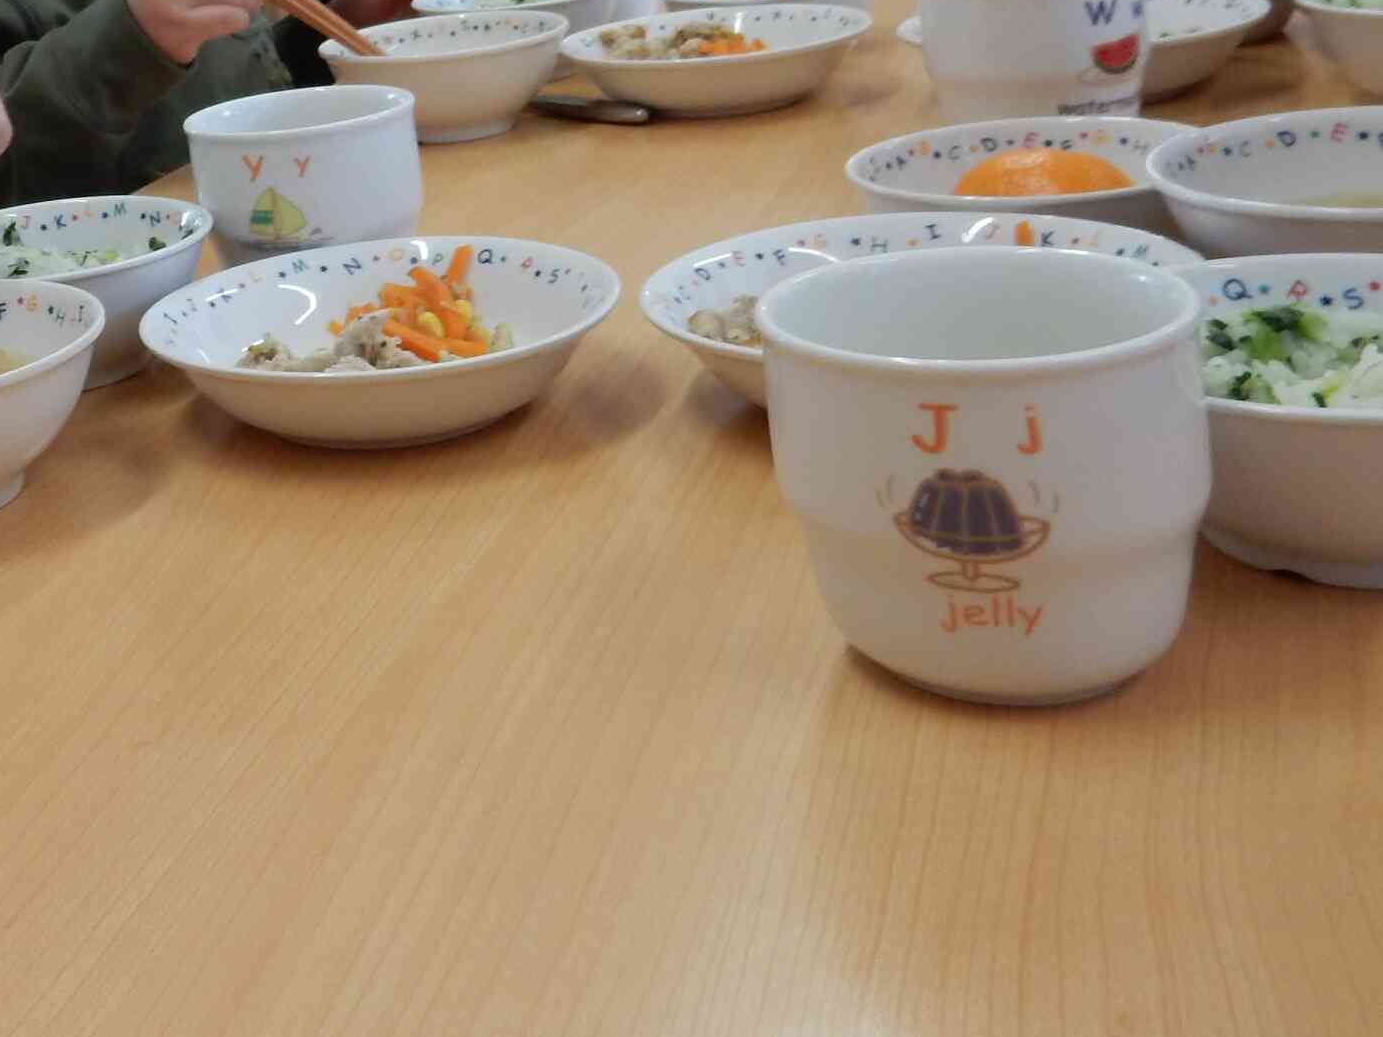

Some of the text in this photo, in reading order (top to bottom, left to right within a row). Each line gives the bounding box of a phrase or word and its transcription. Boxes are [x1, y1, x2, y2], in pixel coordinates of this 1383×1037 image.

[979, 138, 997, 152] D
[1277, 131, 1296, 147] D
[1331, 123, 1348, 141] E
[242, 154, 265, 182] Y
[54, 215, 66, 230] K
[114, 203, 127, 216] M
[149, 211, 161, 227] N
[870, 237, 889, 253] H
[926, 223, 941, 240] I
[1041, 230, 1054, 246] K
[342, 257, 362, 275] N
[478, 249, 492, 264] Q
[548, 269, 559, 284] S
[1223, 278, 1253, 301] Q
[1343, 288, 1364, 310] S
[911, 402, 1043, 455] J j
[939, 594, 1044, 640] jelly
